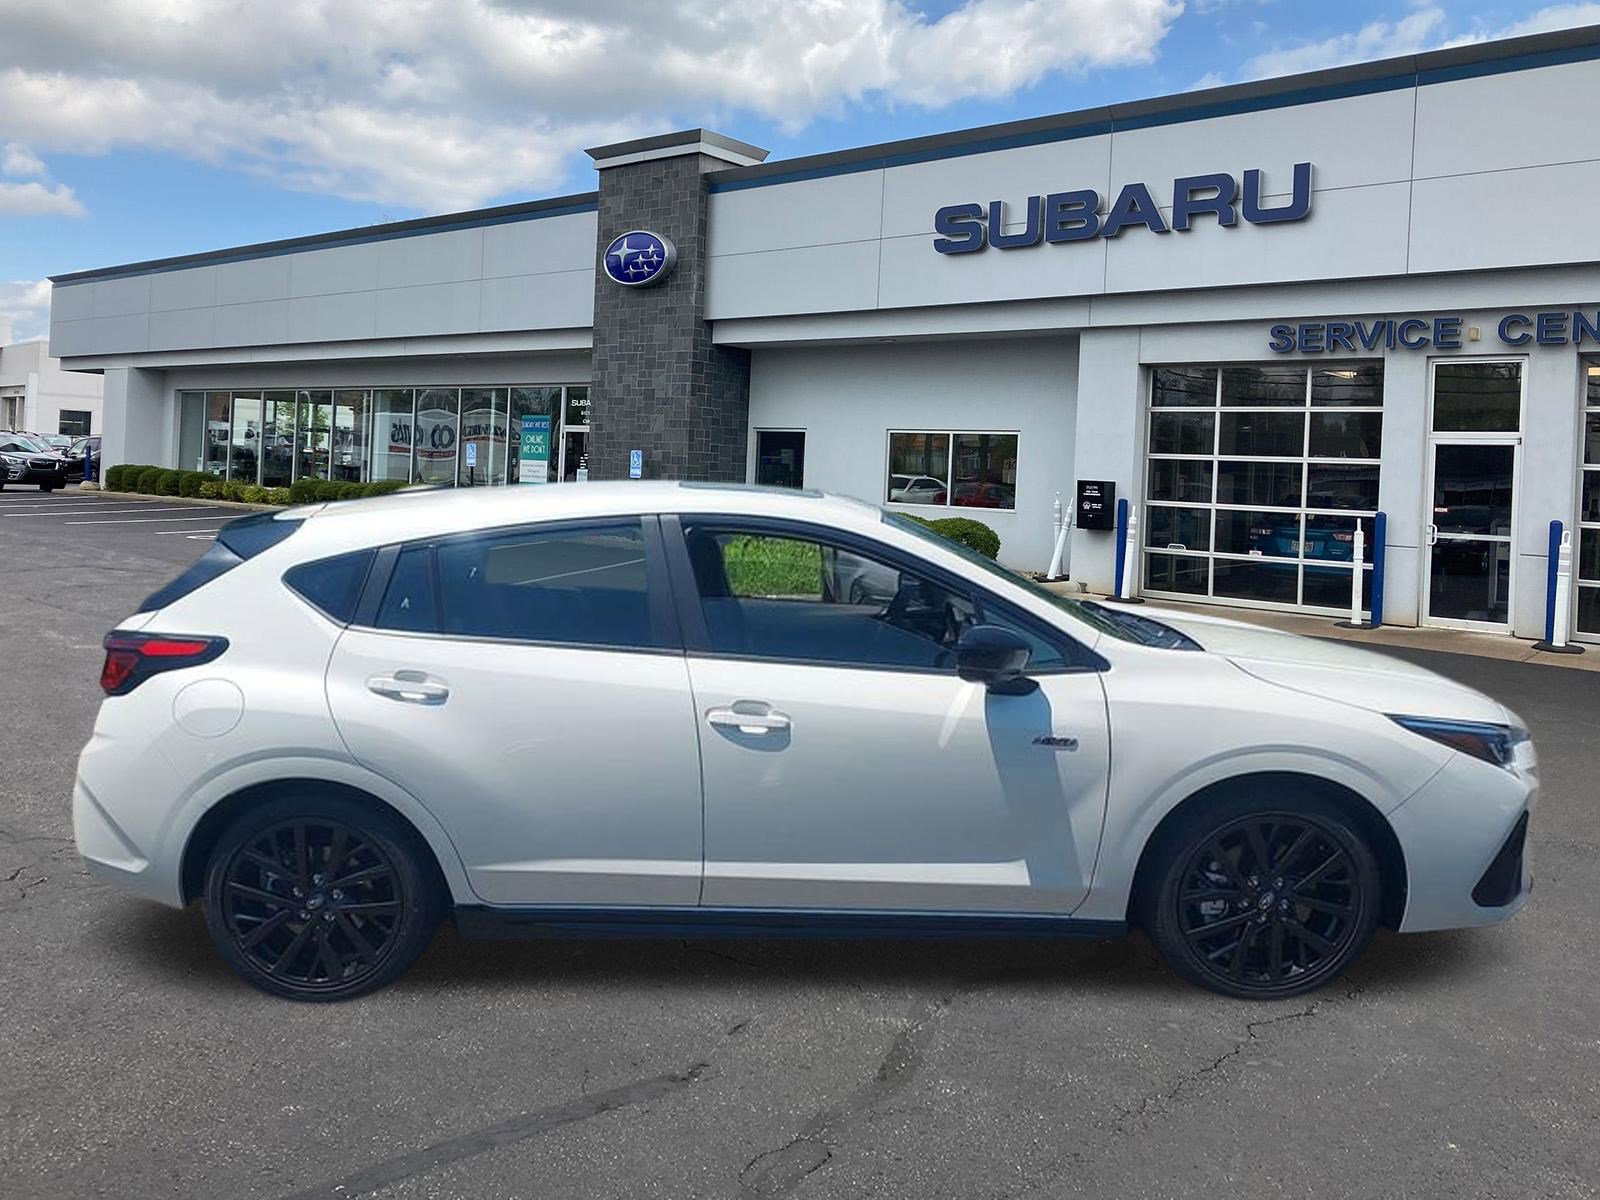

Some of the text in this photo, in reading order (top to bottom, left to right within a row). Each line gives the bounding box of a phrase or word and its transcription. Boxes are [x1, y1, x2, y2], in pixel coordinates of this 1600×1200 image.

[933, 162, 1313, 255] SUBARU
[1269, 311, 1600, 353] SERVICE CEN
